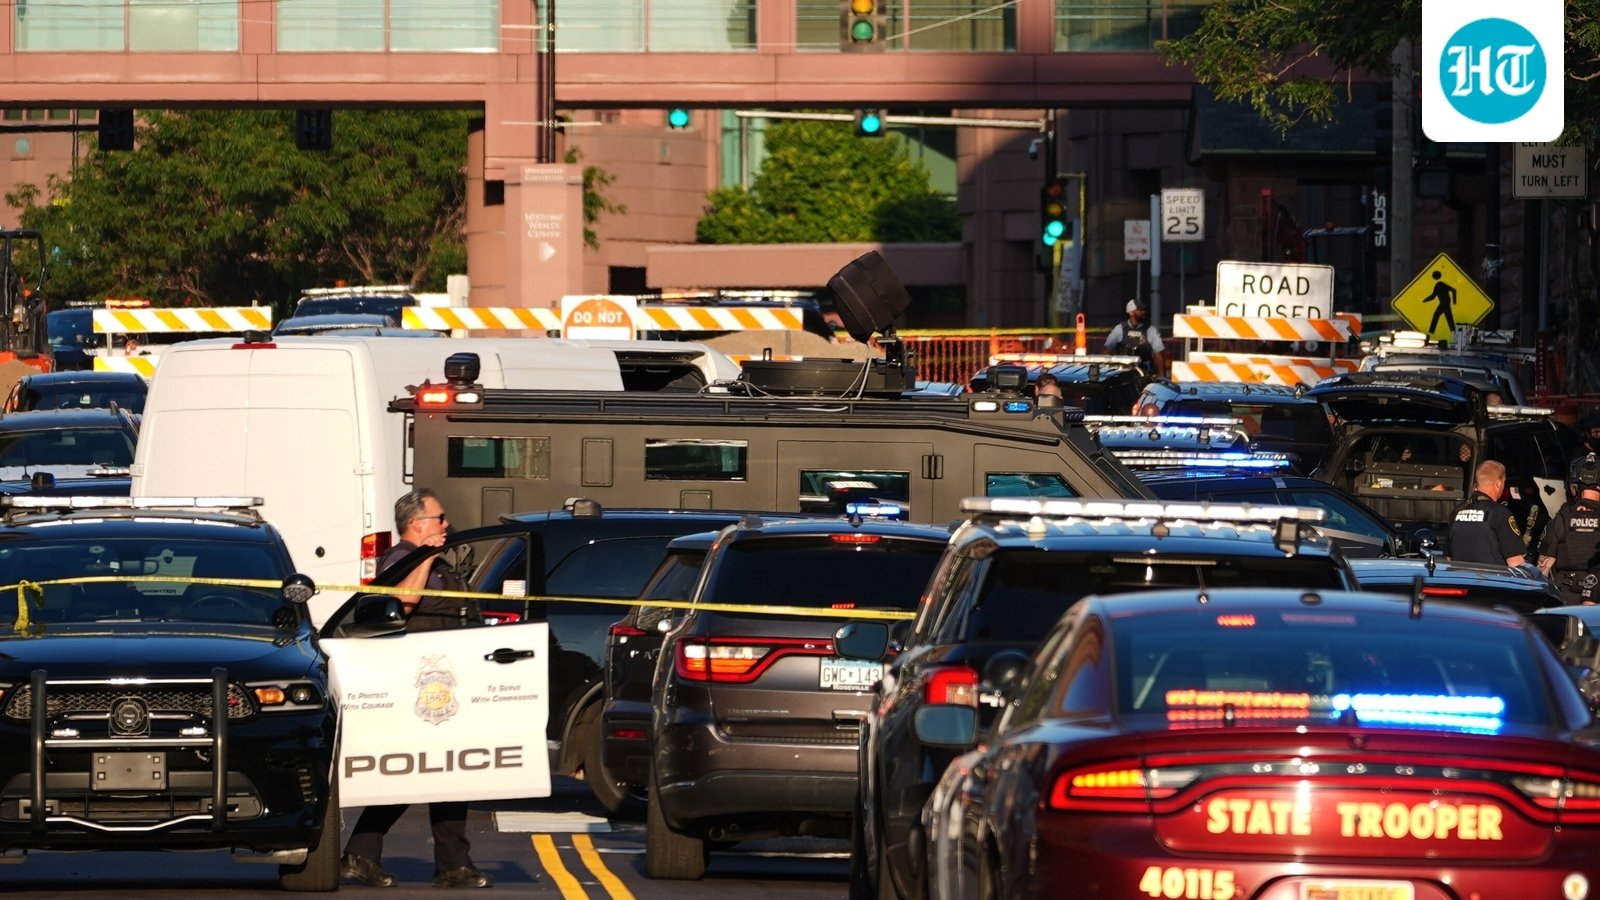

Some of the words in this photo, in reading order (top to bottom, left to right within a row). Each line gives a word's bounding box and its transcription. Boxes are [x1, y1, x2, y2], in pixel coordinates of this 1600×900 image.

[1532, 154, 1566, 168] MUST
[1521, 175, 1548, 187] TURN
[1554, 175, 1579, 187] LEFT
[1166, 195, 1200, 204] SPEED
[1169, 206, 1195, 214] LIMIT
[1167, 216, 1199, 235] 25
[1372, 195, 1386, 247] subs
[1242, 274, 1310, 296] ROAD
[573, 311, 592, 324] DO
[597, 311, 623, 324] NOT
[1570, 518, 1599, 528] POLICE
[823, 667, 847, 683] GWC
[857, 667, 880, 684] 143
[345, 746, 523, 778] POLICE
[1207, 798, 1311, 835] STATE
[1336, 802, 1504, 840] TROOPER
[1139, 866, 1235, 900] 40115
